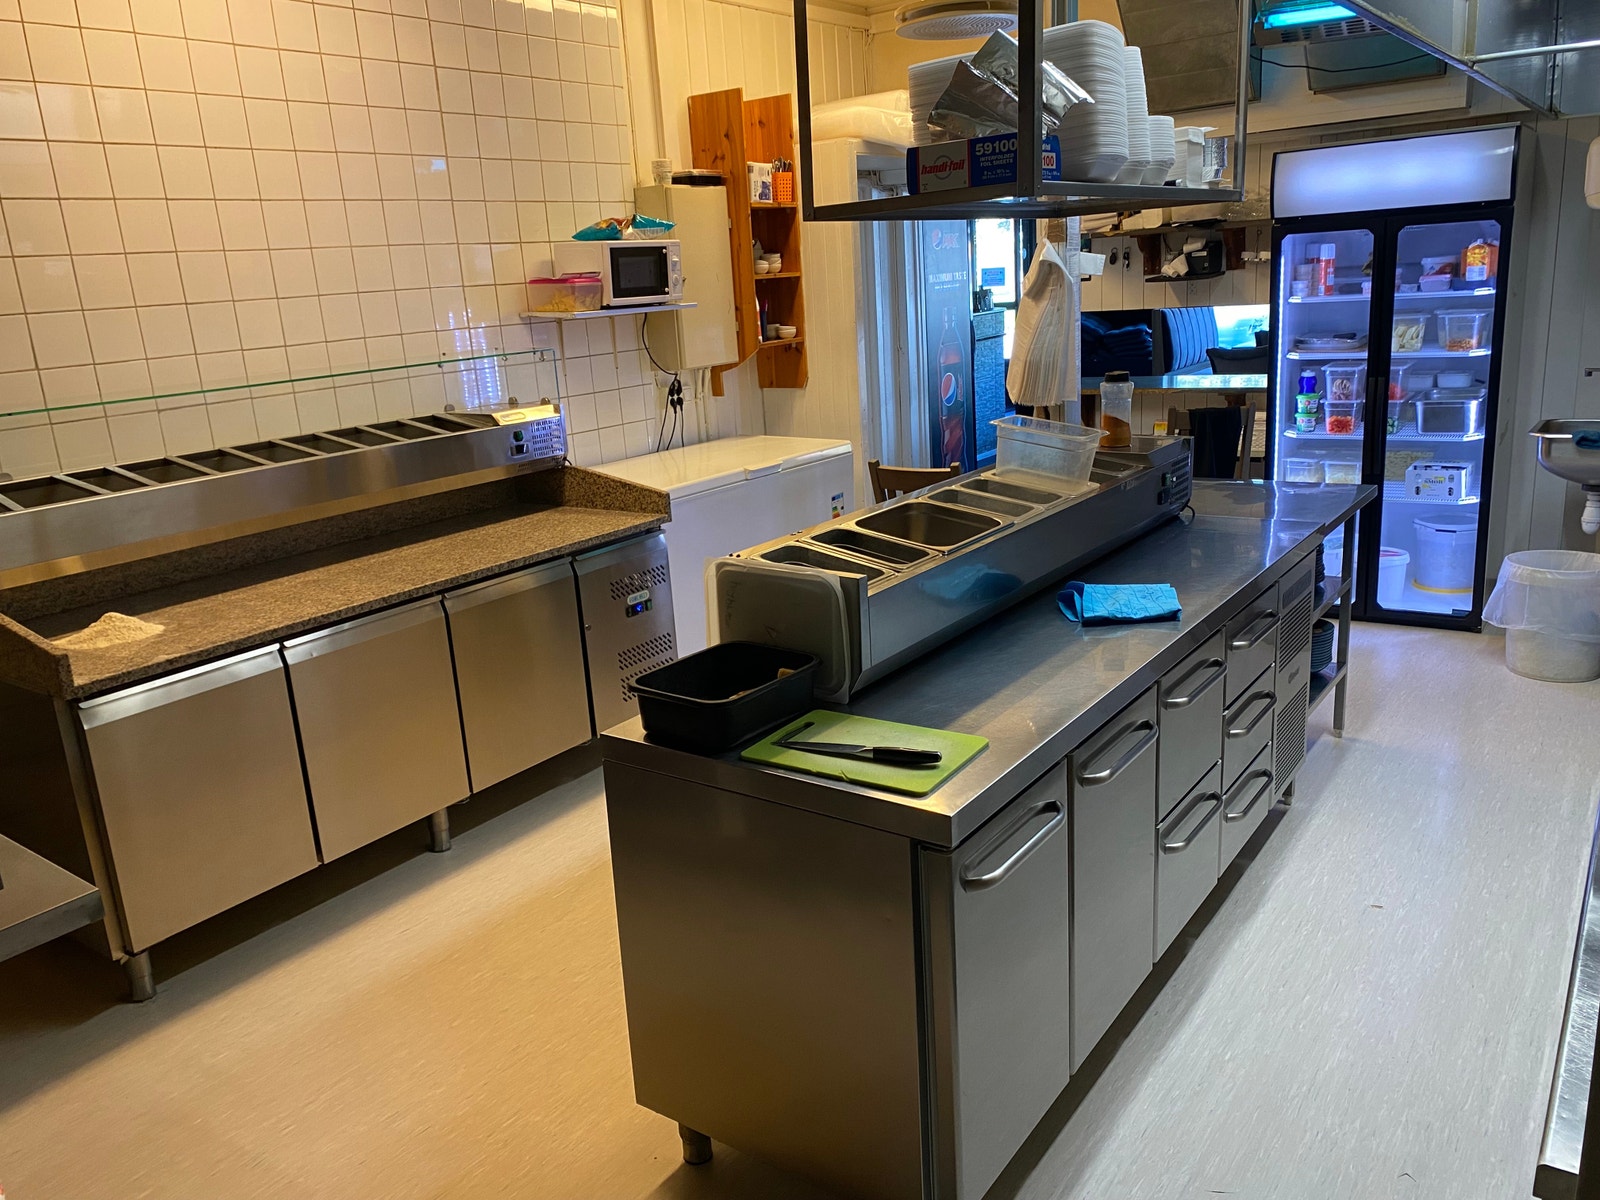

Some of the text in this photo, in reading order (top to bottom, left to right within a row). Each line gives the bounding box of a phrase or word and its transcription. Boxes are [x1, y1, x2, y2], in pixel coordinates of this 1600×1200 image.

[975, 138, 1018, 156] 59100
[921, 158, 965, 175] handi-foil
[1042, 155, 1054, 167] 100
